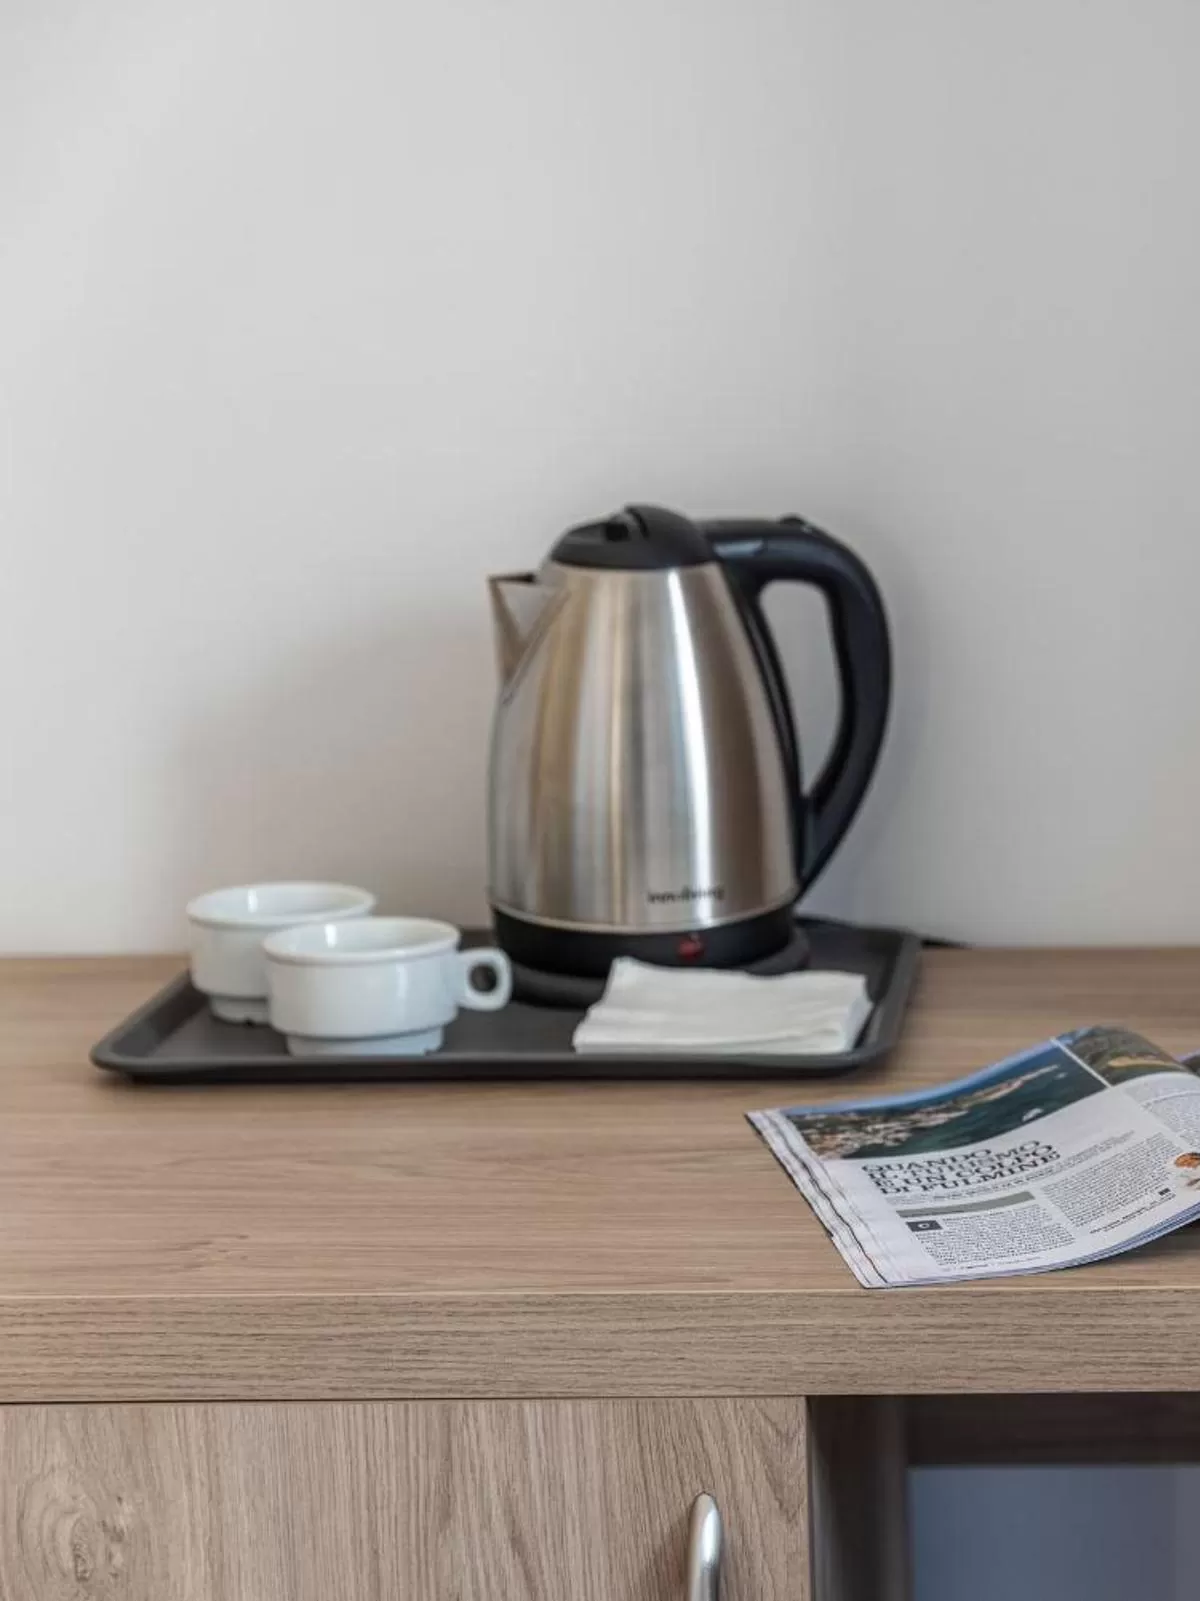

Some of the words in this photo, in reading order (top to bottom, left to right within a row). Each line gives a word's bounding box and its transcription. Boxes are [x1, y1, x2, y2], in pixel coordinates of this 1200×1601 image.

[861, 1149, 992, 1172] QUANDO
[903, 1174, 948, 1185] UN
[955, 1145, 1053, 1178] COLPO
[919, 1151, 1061, 1192] FULMINE
